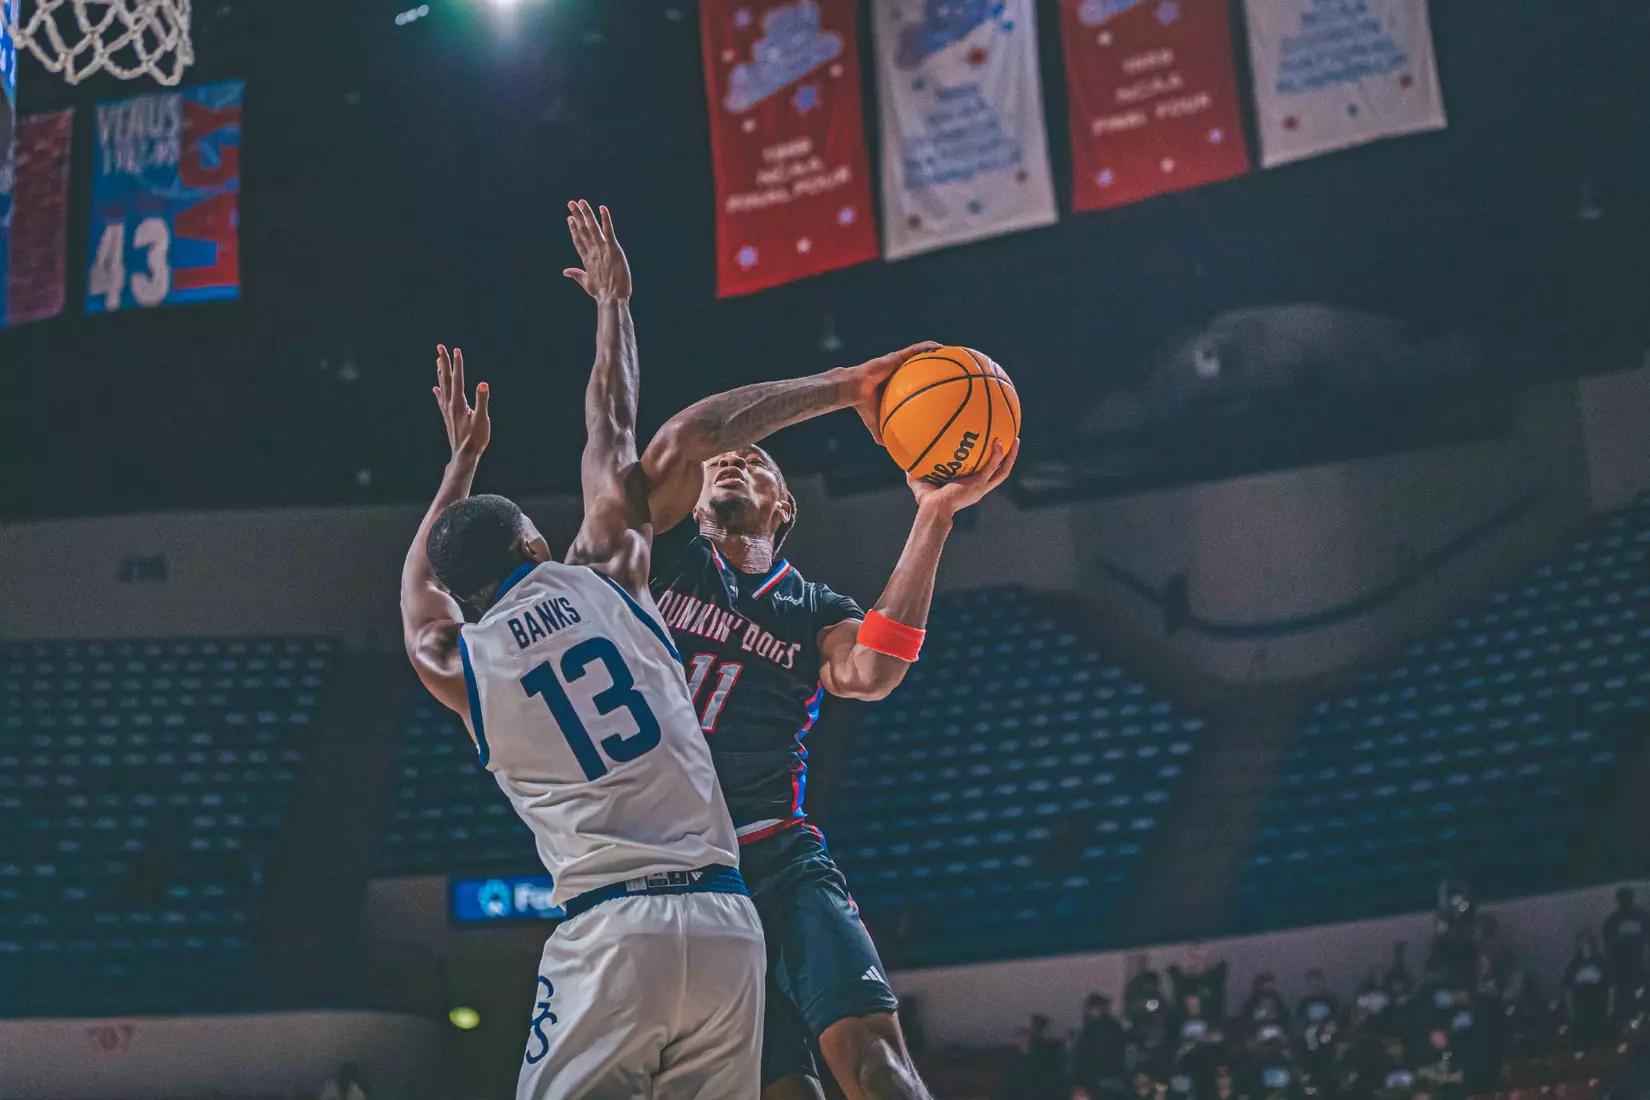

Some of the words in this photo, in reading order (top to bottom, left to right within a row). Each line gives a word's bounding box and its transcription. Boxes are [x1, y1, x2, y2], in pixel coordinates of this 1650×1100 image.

[89, 217, 170, 309] 43
[507, 597, 582, 650] BANKS
[741, 621, 801, 670] DOGS
[520, 637, 662, 782] 13
[688, 652, 744, 733] 11
